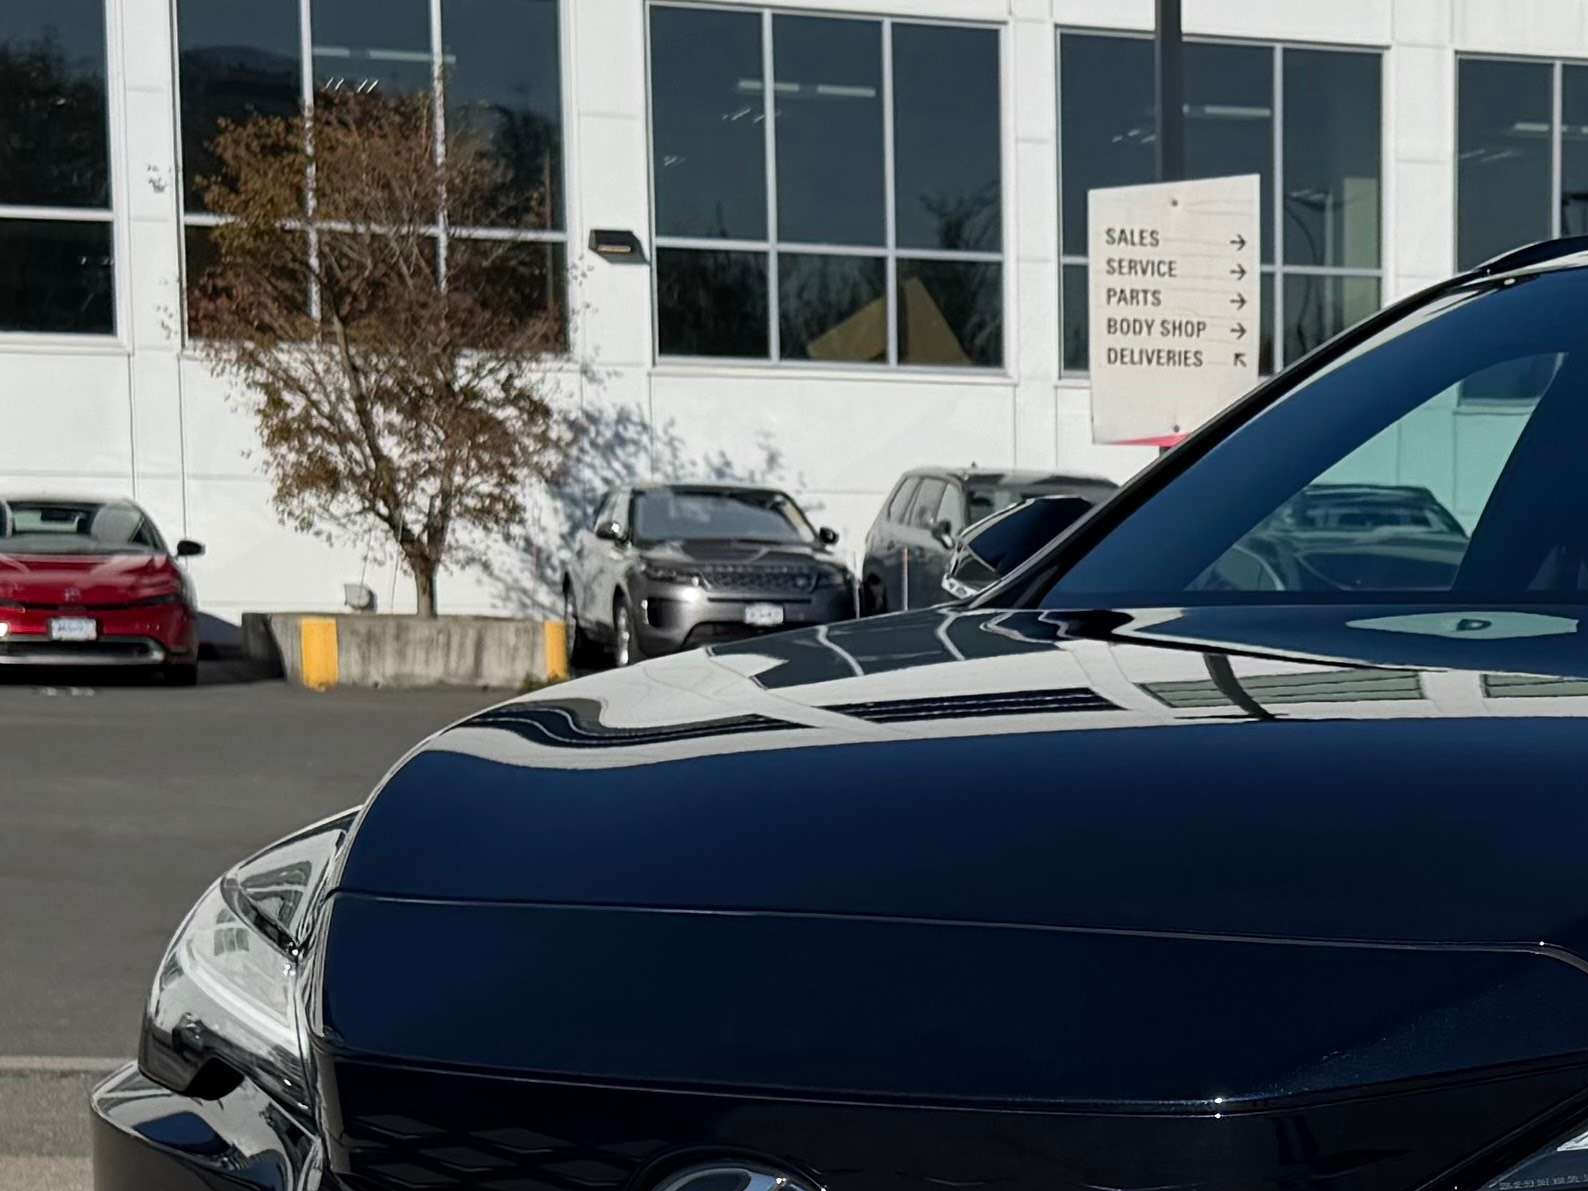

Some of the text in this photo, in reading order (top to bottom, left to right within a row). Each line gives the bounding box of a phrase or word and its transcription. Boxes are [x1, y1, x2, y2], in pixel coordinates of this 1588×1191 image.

[1105, 228, 1160, 247] SALES
[1105, 259, 1178, 278] SERVICE
[1106, 288, 1162, 307] PARTS
[1107, 318, 1207, 338] BODY SHOP
[1107, 347, 1204, 368] DELIVERIES
